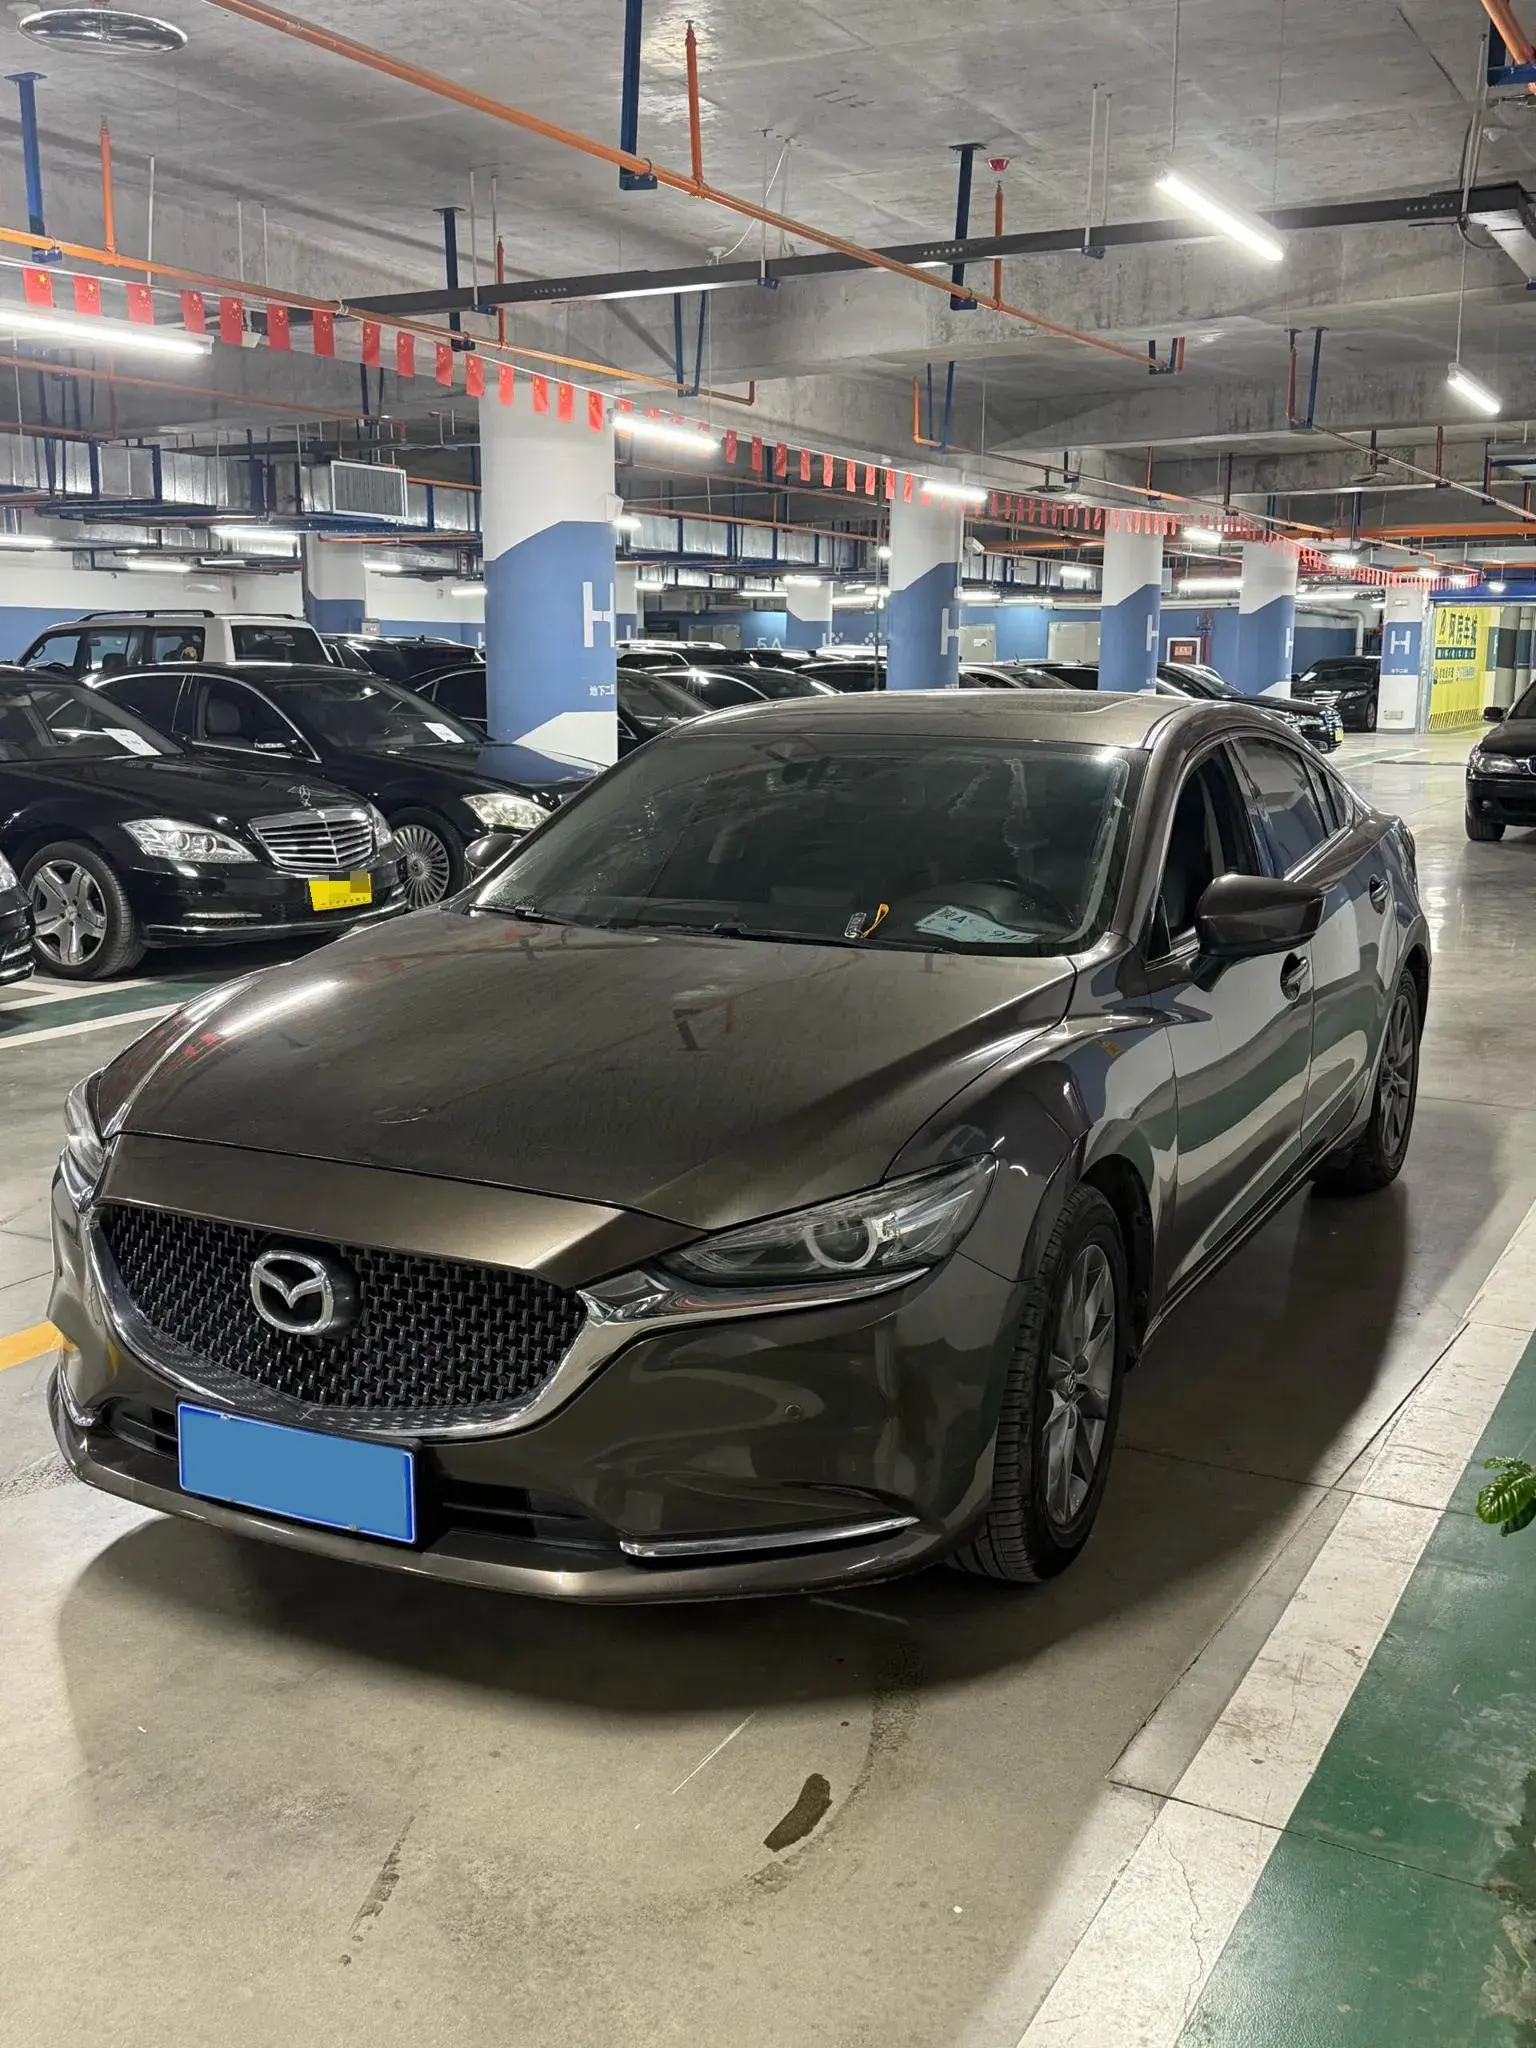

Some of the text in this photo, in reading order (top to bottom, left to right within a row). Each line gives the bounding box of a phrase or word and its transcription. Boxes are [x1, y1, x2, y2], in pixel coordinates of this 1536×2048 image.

[583, 582, 615, 647] H
[940, 608, 960, 655] H
[1390, 631, 1411, 655] H
